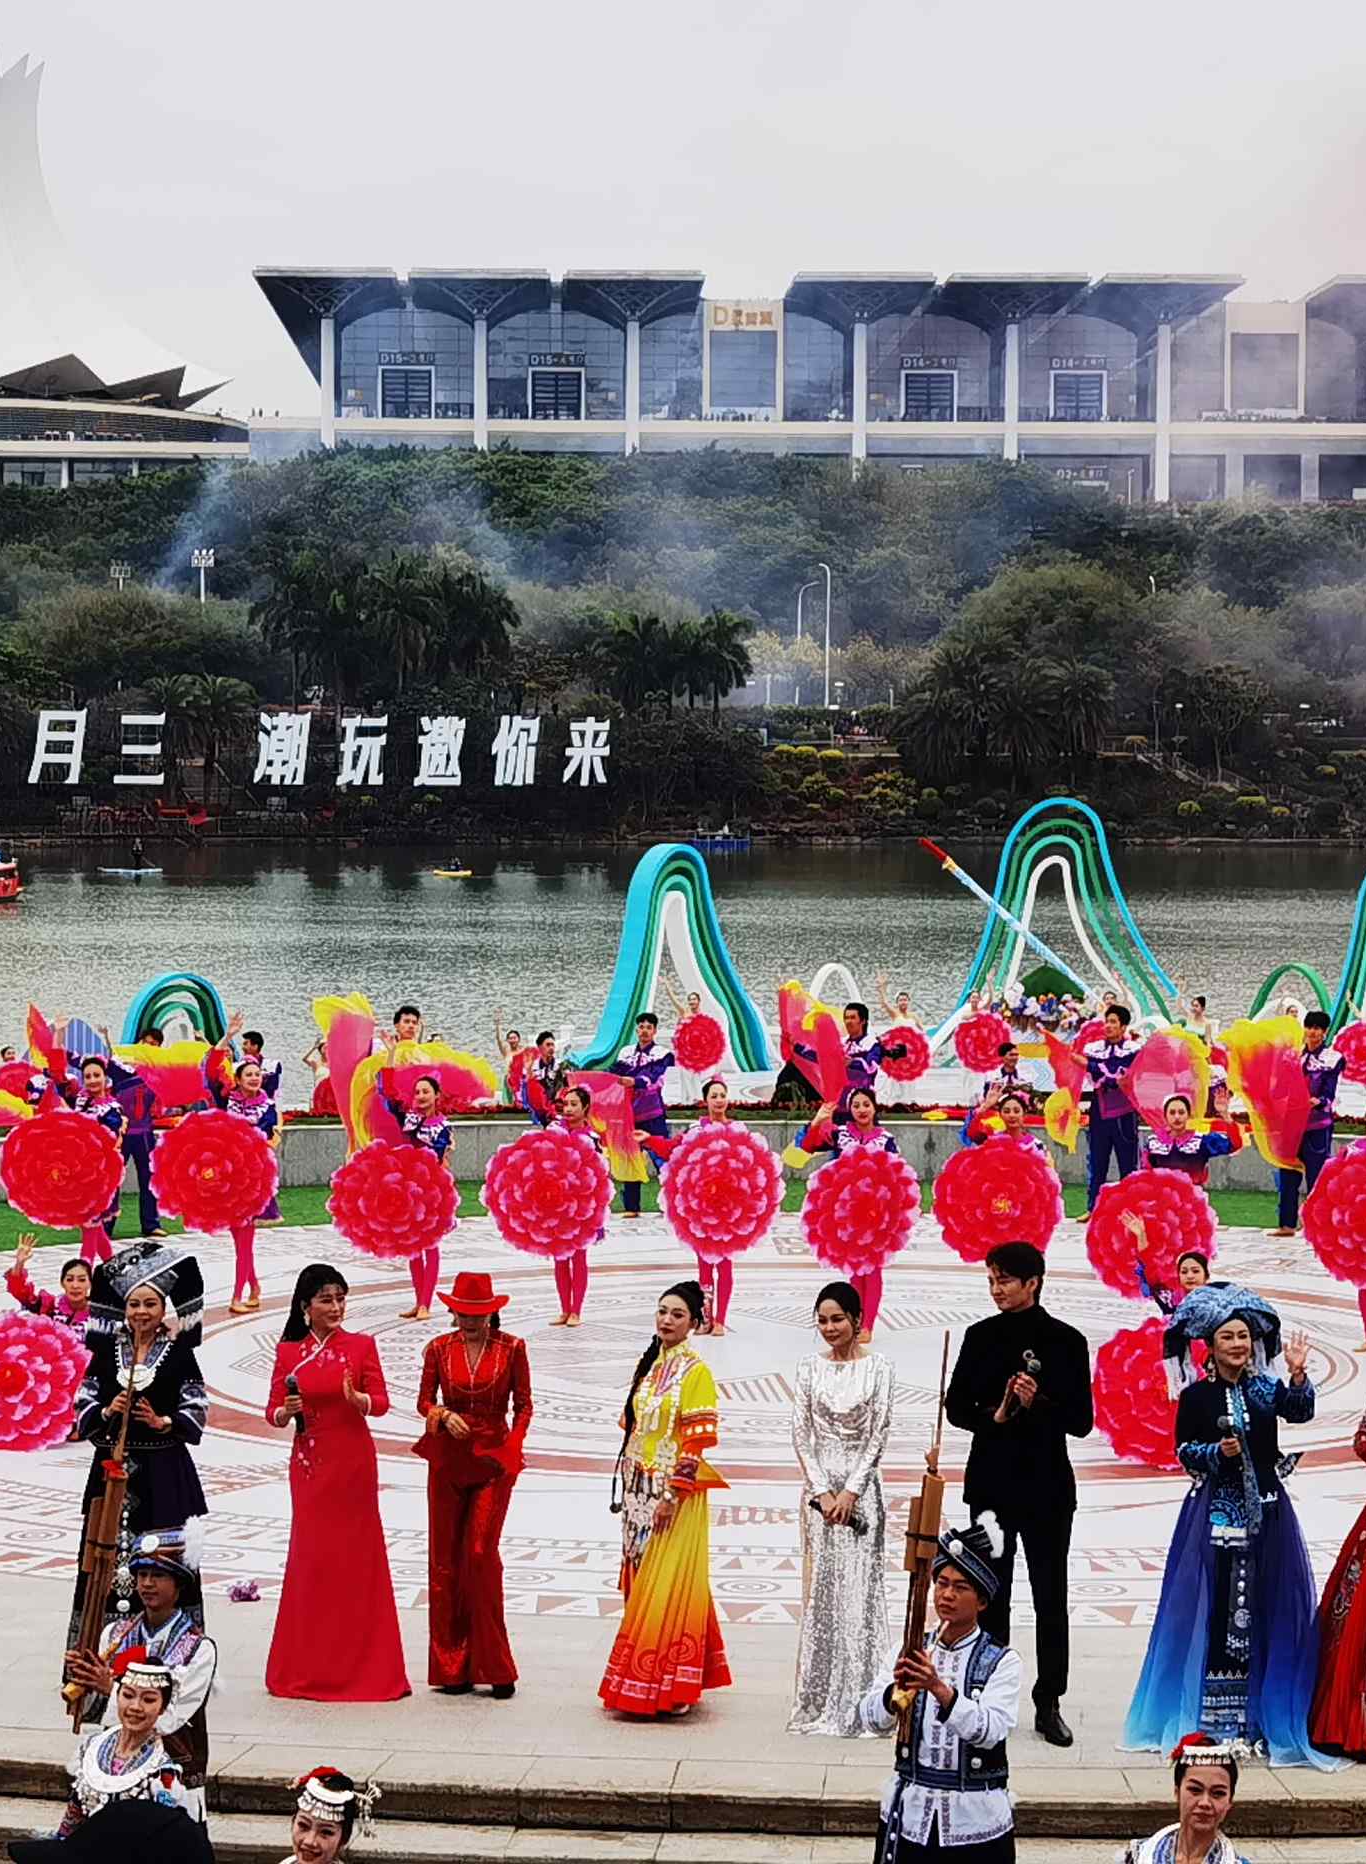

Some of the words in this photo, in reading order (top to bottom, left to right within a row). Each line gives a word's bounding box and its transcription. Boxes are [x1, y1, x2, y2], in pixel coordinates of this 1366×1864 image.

[252, 711, 611, 787] 潮玩邀你来
